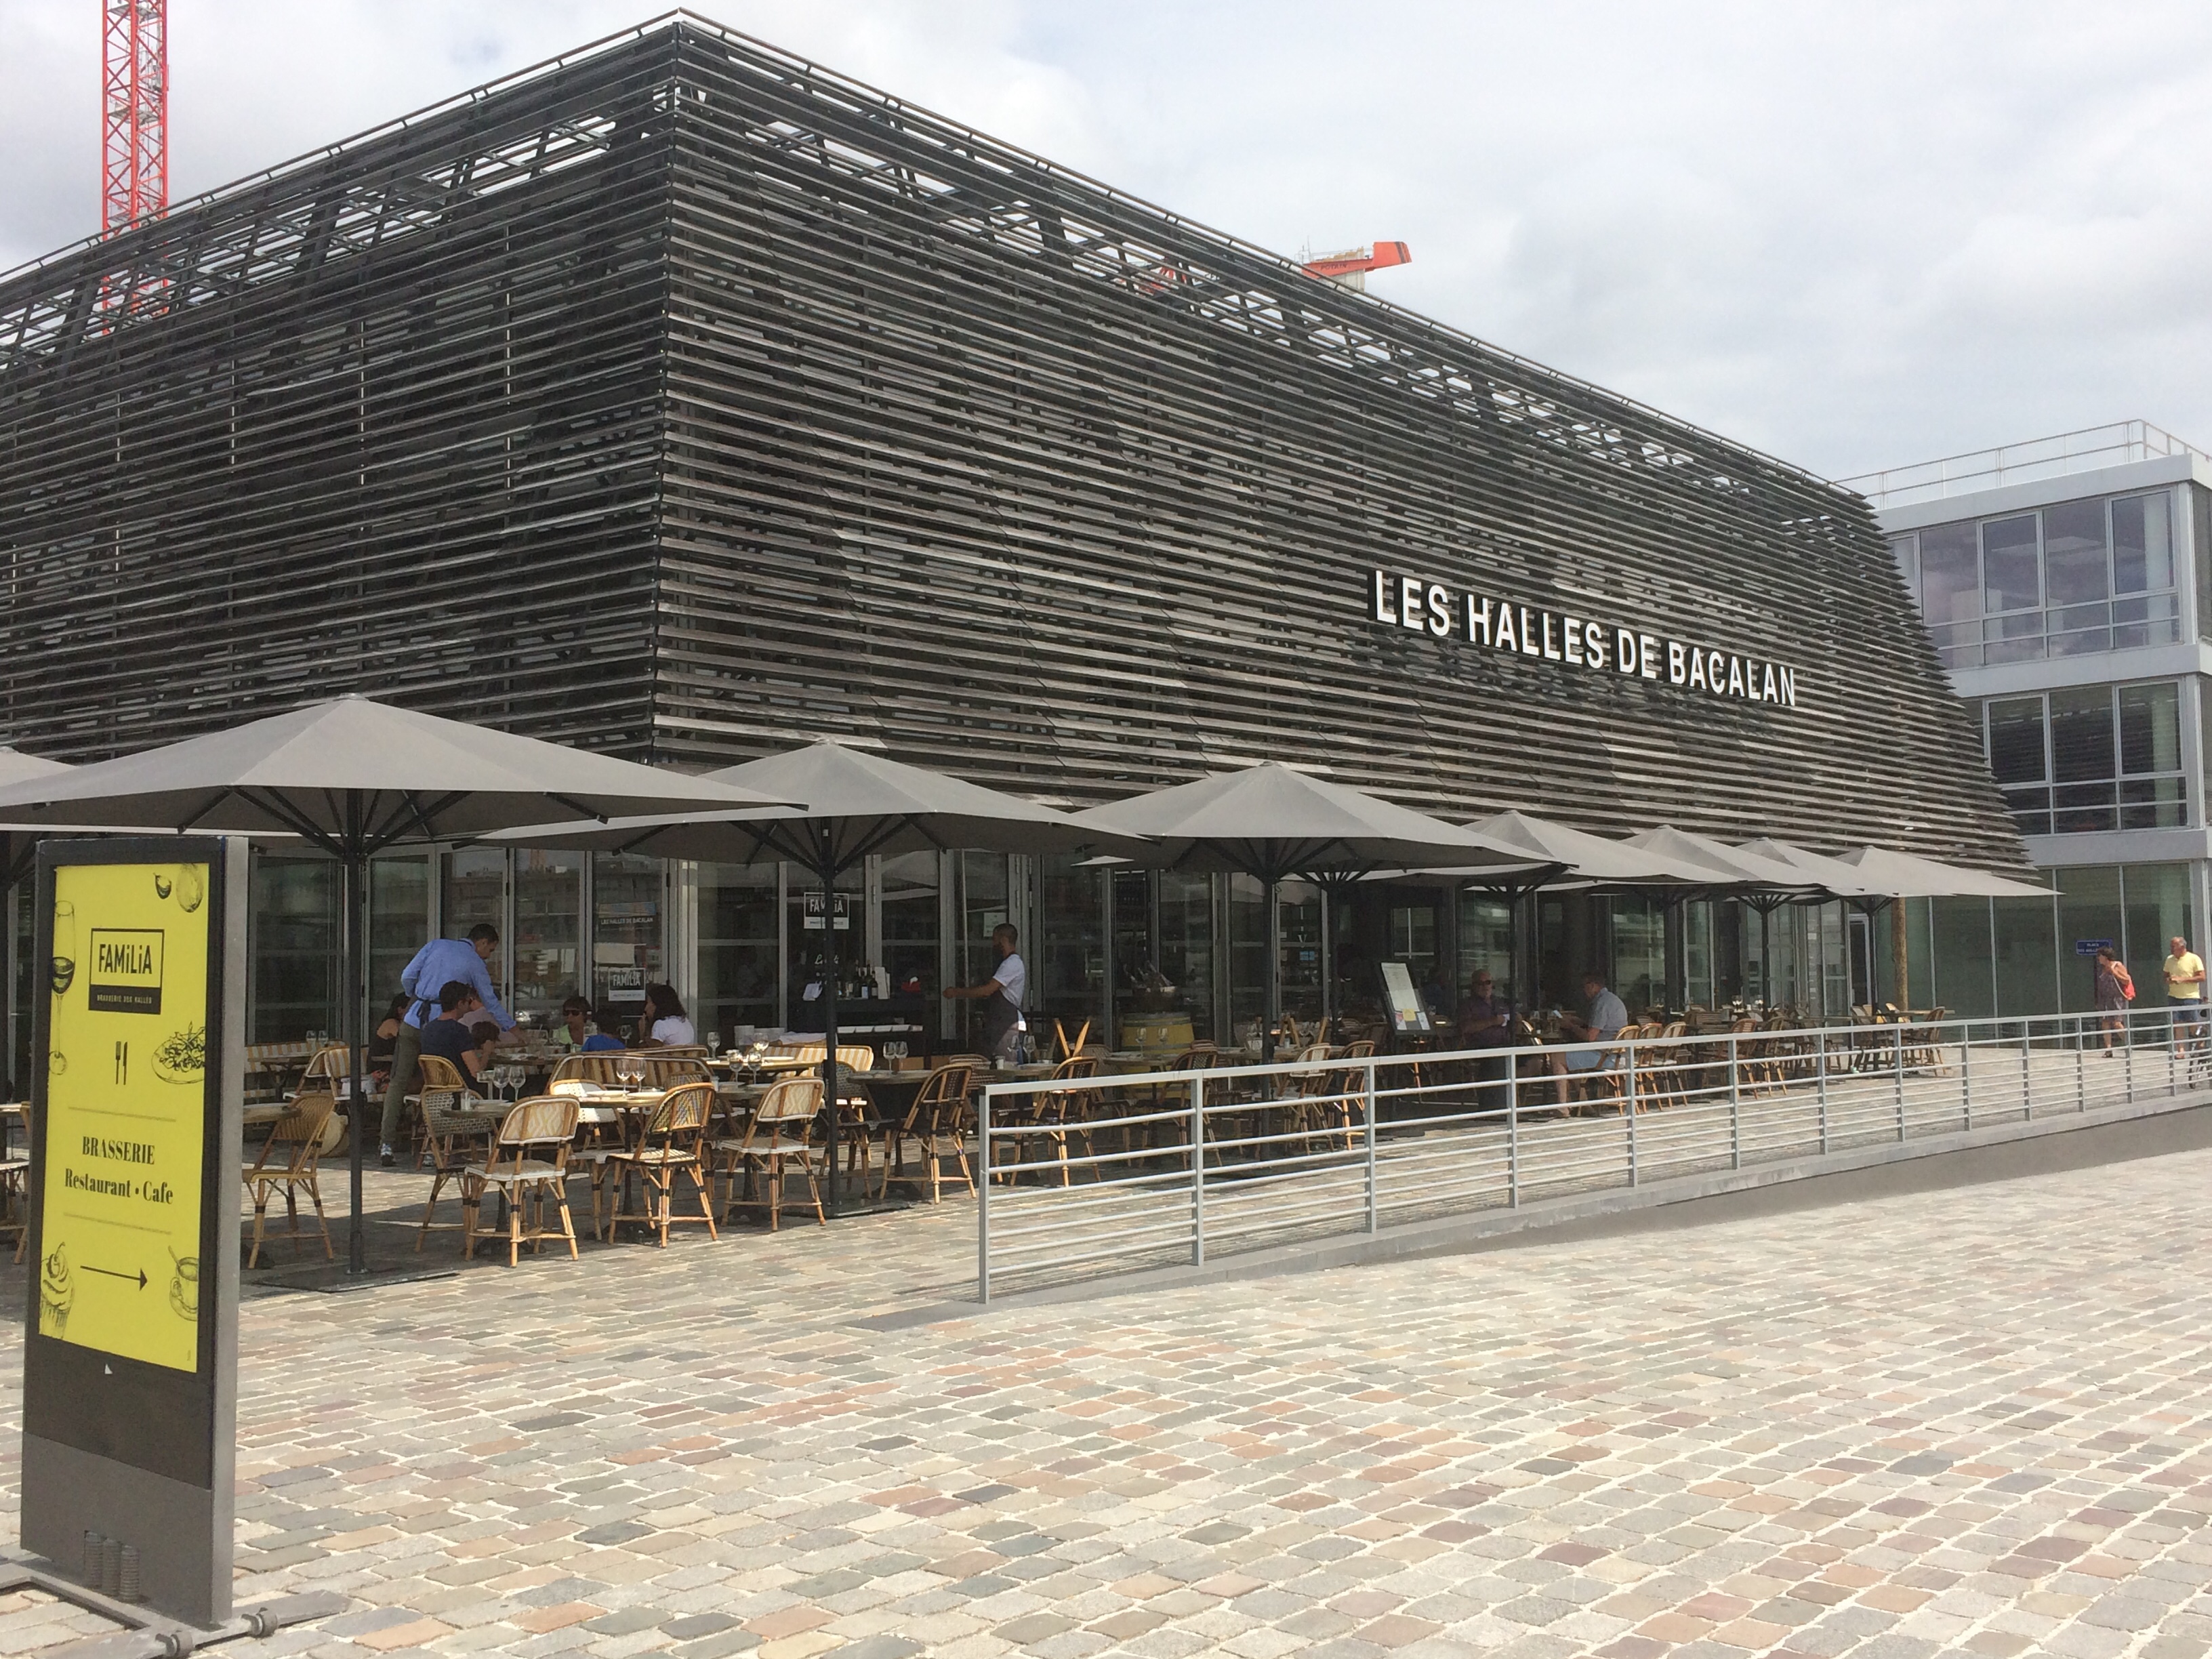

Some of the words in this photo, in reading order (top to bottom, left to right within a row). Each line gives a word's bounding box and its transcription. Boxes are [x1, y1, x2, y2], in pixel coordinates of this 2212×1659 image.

[1376, 570, 1450, 636] LES
[1468, 594, 1604, 669] HALLES
[1617, 629, 1657, 679] DE
[1668, 641, 1795, 706] BACALAN
[82, 1136, 155, 1165] BRASSERIE
[65, 1168, 131, 1197] Restaurant
[143, 1181, 173, 1204] Cafe
